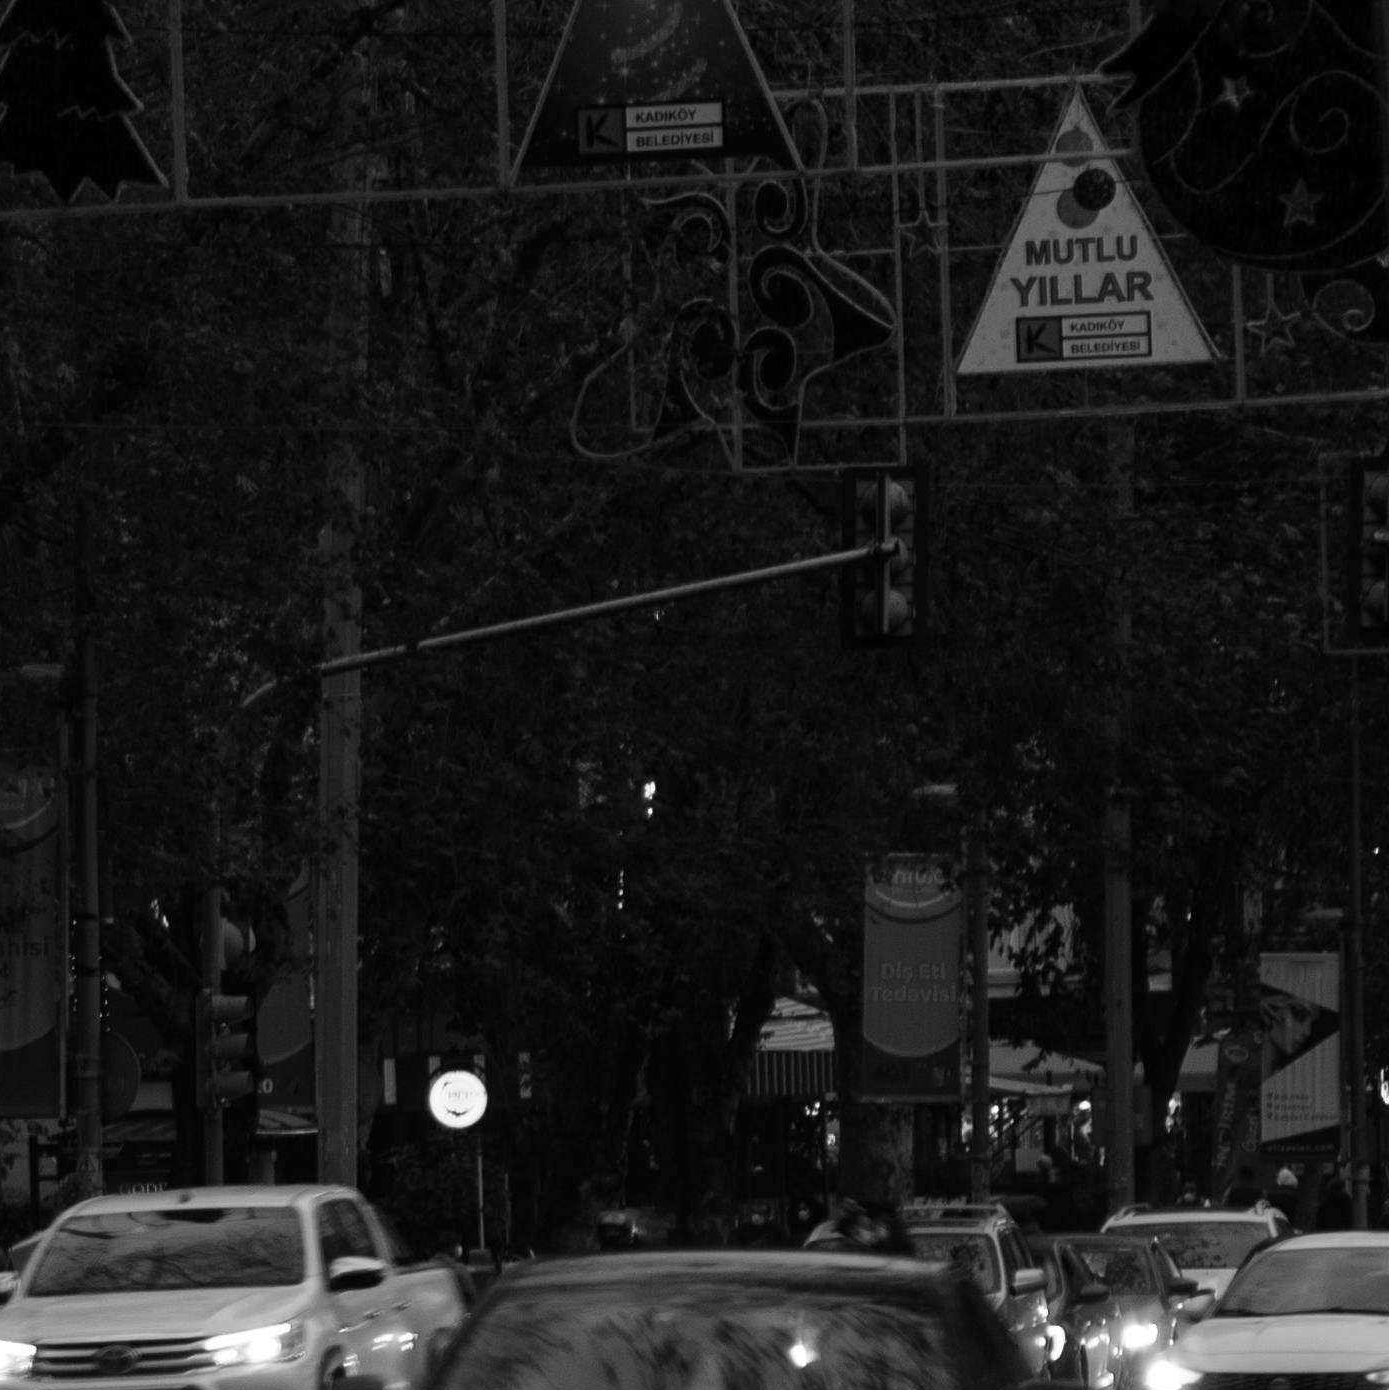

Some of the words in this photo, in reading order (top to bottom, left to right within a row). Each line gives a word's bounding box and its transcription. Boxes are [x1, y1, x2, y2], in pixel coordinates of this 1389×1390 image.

[636, 108, 696, 123] KADIKÖY
[636, 129, 714, 148] BELEDİYESİ
[1025, 234, 1138, 266] MUTLU
[1010, 271, 1154, 307] YILLAR
[1070, 318, 1125, 333] KADIKÖY
[1070, 338, 1141, 354] BELEDİYESİ
[869, 984, 956, 1002] Tedavisi
